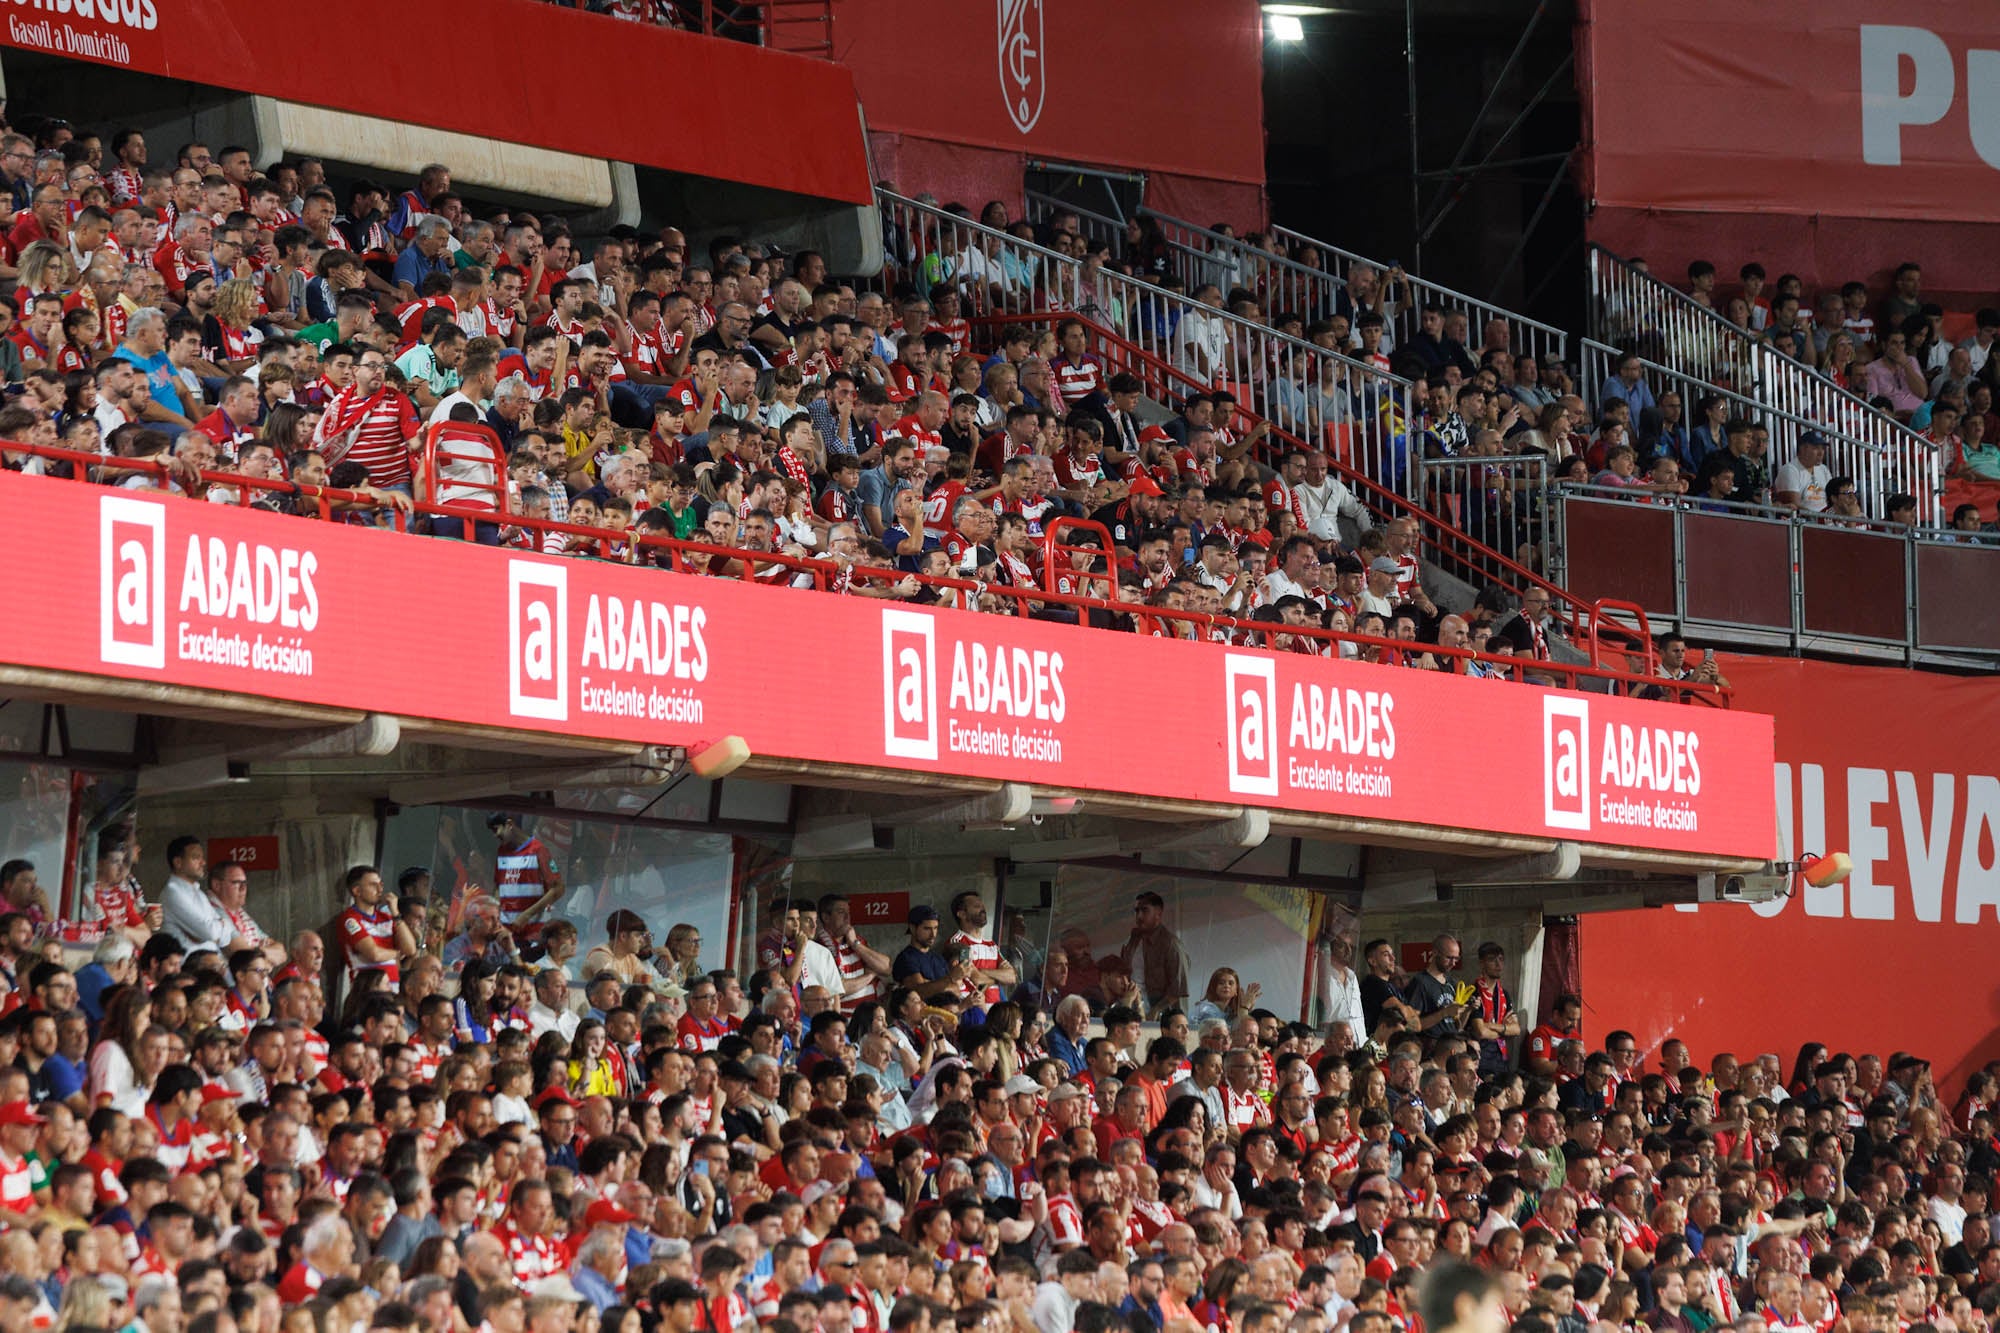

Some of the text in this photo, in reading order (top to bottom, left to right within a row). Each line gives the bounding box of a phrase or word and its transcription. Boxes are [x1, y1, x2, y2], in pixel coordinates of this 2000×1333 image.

[9, 14, 52, 48] Gasoil
[54, 28, 65, 50] a
[64, 24, 130, 64] Domicilio
[179, 534, 319, 633] ABADES
[179, 622, 312, 676] Excelente decisión
[581, 594, 708, 683] ABADES
[581, 677, 703, 725] Excelente decisión
[949, 640, 1065, 724] ABADES
[949, 718, 1061, 763] Excelente decisión
[1289, 682, 1395, 761] ABADES
[1289, 756, 1391, 798] Excelente decisión
[1600, 722, 1700, 795] ABADES
[1600, 793, 1697, 832] Excelente decisión
[230, 847, 257, 863] 123
[865, 902, 889, 916] 122
